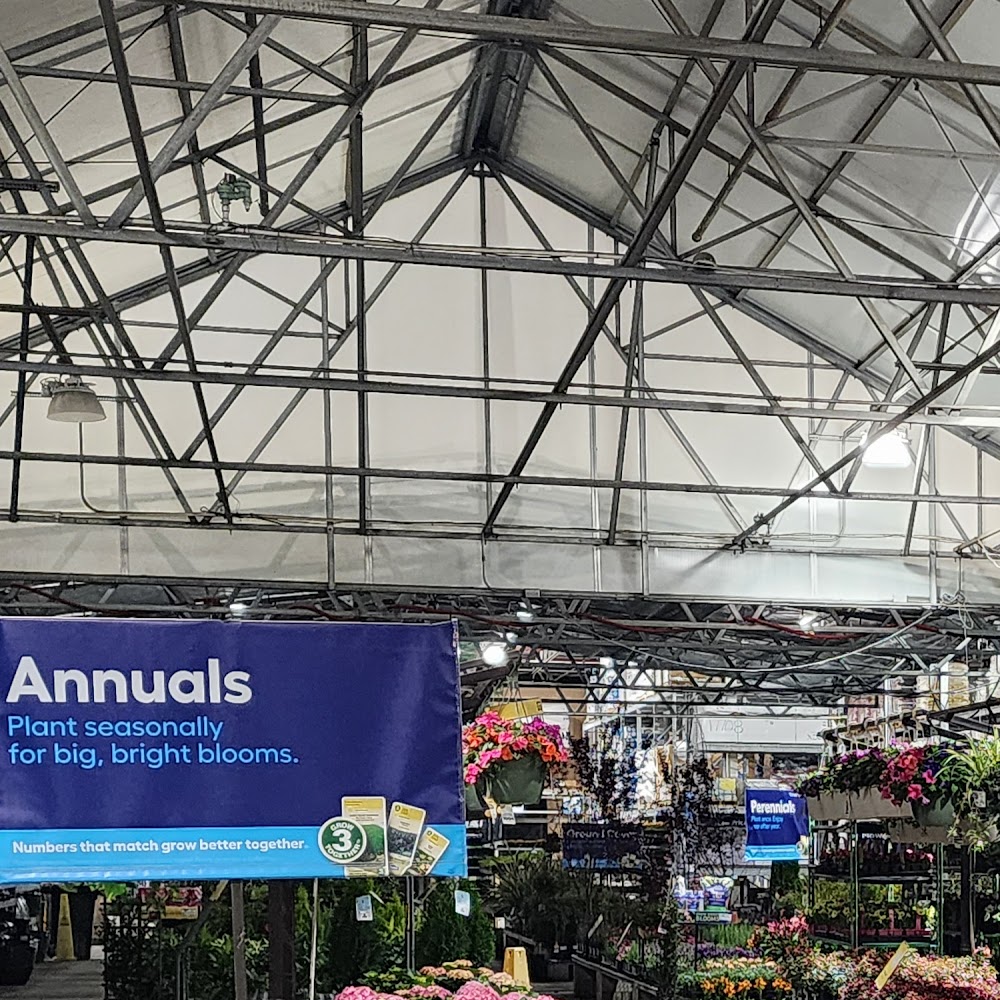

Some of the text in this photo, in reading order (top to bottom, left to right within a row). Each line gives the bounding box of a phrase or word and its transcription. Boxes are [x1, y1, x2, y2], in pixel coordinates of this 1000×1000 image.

[7, 655, 253, 704] Annuals
[7, 715, 224, 742] Plant seasonally
[8, 741, 300, 769] for big, bright blooms.
[750, 799, 796, 814] Perennials
[329, 820, 355, 831] GROW
[12, 841, 77, 854] Numbers
[79, 840, 110, 852] that
[113, 839, 160, 852] match
[161, 841, 197, 853] grow
[199, 838, 243, 851] better
[332, 828, 352, 852] 3
